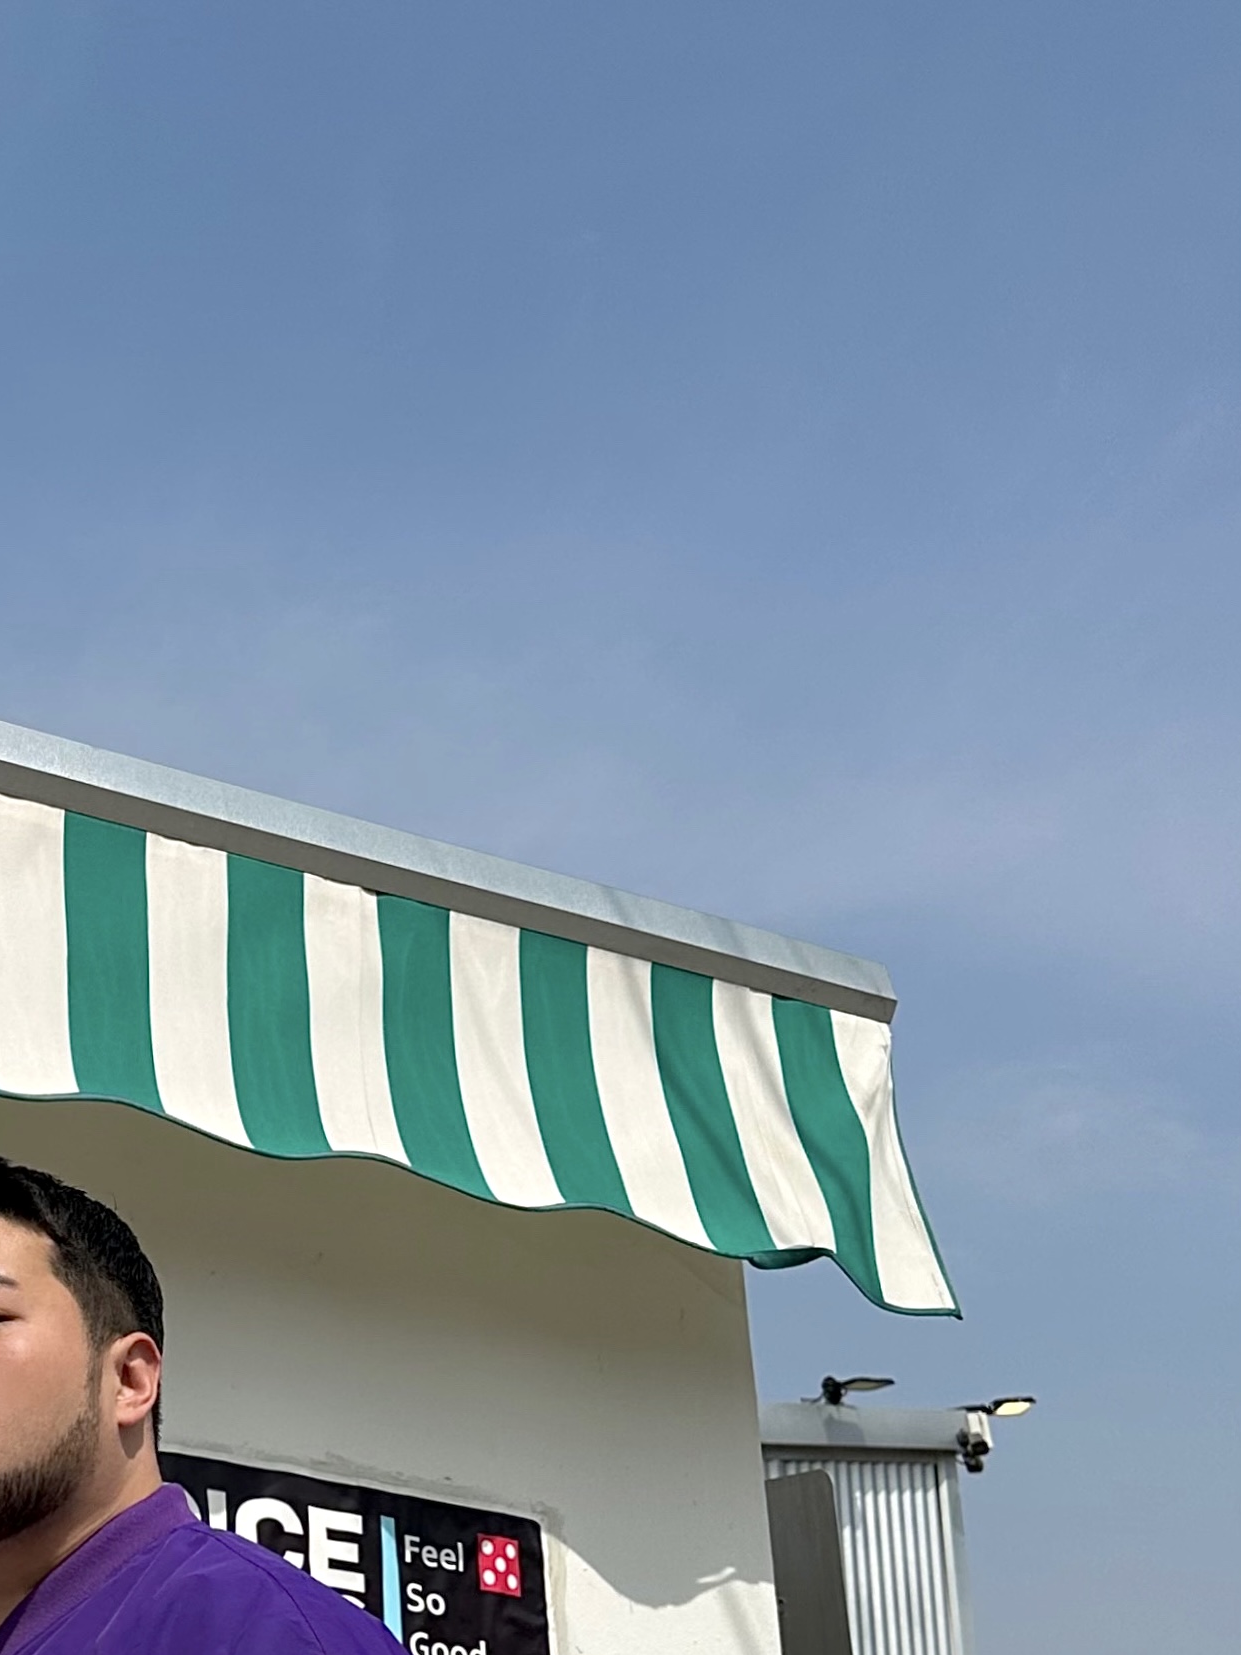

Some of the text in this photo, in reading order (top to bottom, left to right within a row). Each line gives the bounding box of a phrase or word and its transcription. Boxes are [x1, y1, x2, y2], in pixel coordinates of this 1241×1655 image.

[183, 1488, 366, 1594] ICE
[403, 1533, 465, 1573] Feel
[406, 1582, 446, 1616] So
